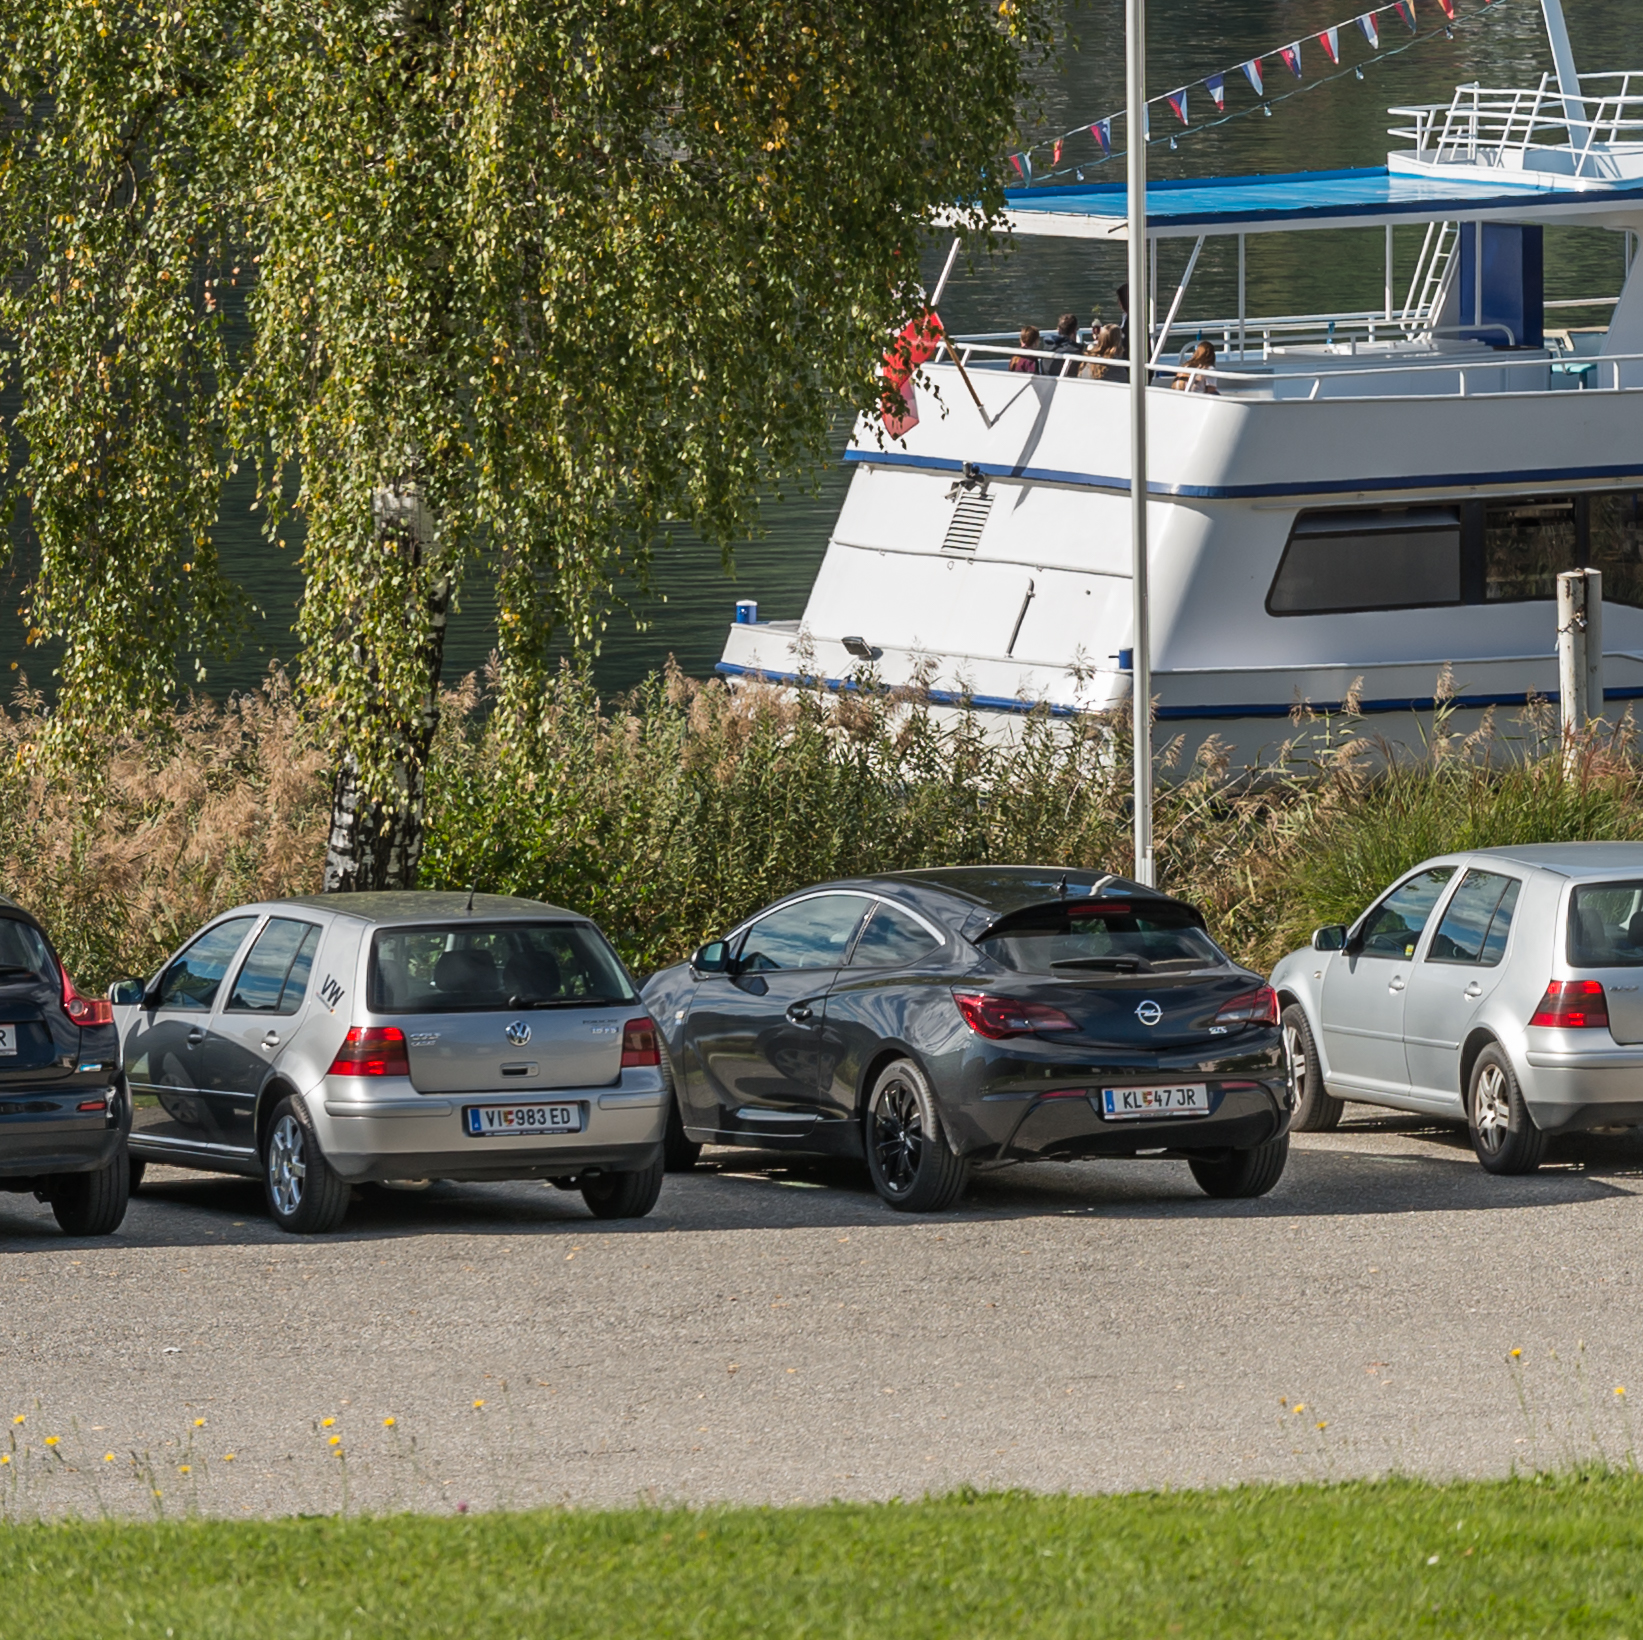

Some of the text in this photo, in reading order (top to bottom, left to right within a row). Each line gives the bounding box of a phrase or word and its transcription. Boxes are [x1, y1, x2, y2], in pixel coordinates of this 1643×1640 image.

[1122, 1088, 1196, 1109] KL 47 JR
[486, 1108, 570, 1128] VI 983 ED
